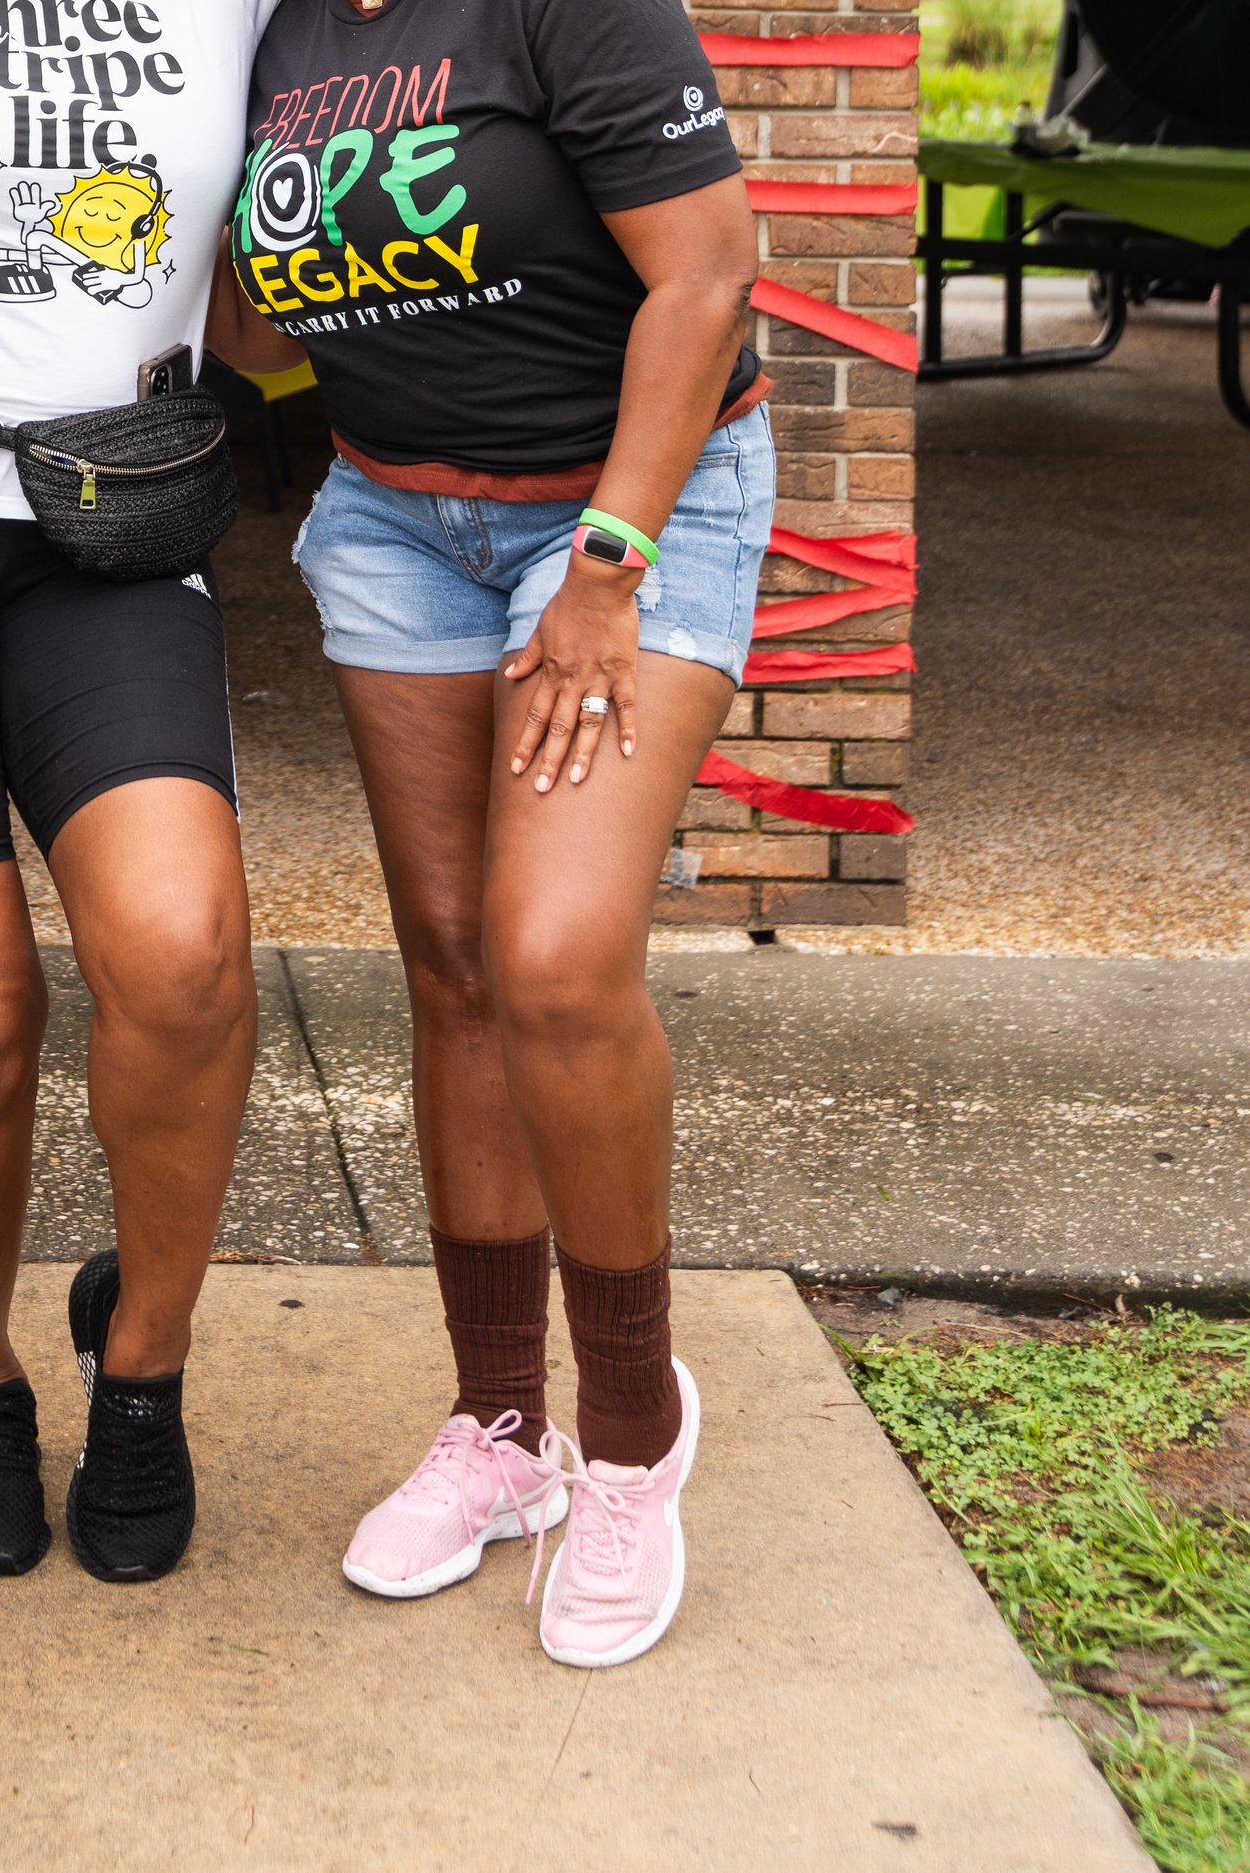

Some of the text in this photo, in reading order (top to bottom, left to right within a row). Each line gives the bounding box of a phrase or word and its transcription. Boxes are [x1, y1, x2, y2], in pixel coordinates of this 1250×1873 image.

[9, 96, 157, 169] life.
[254, 58, 452, 150] FREEDOM
[232, 124, 467, 255] HOPE
[233, 224, 479, 314] LEGACY
[285, 311, 350, 336] CARRY
[355, 306, 381, 326] IT
[387, 278, 523, 319] FORWARD
